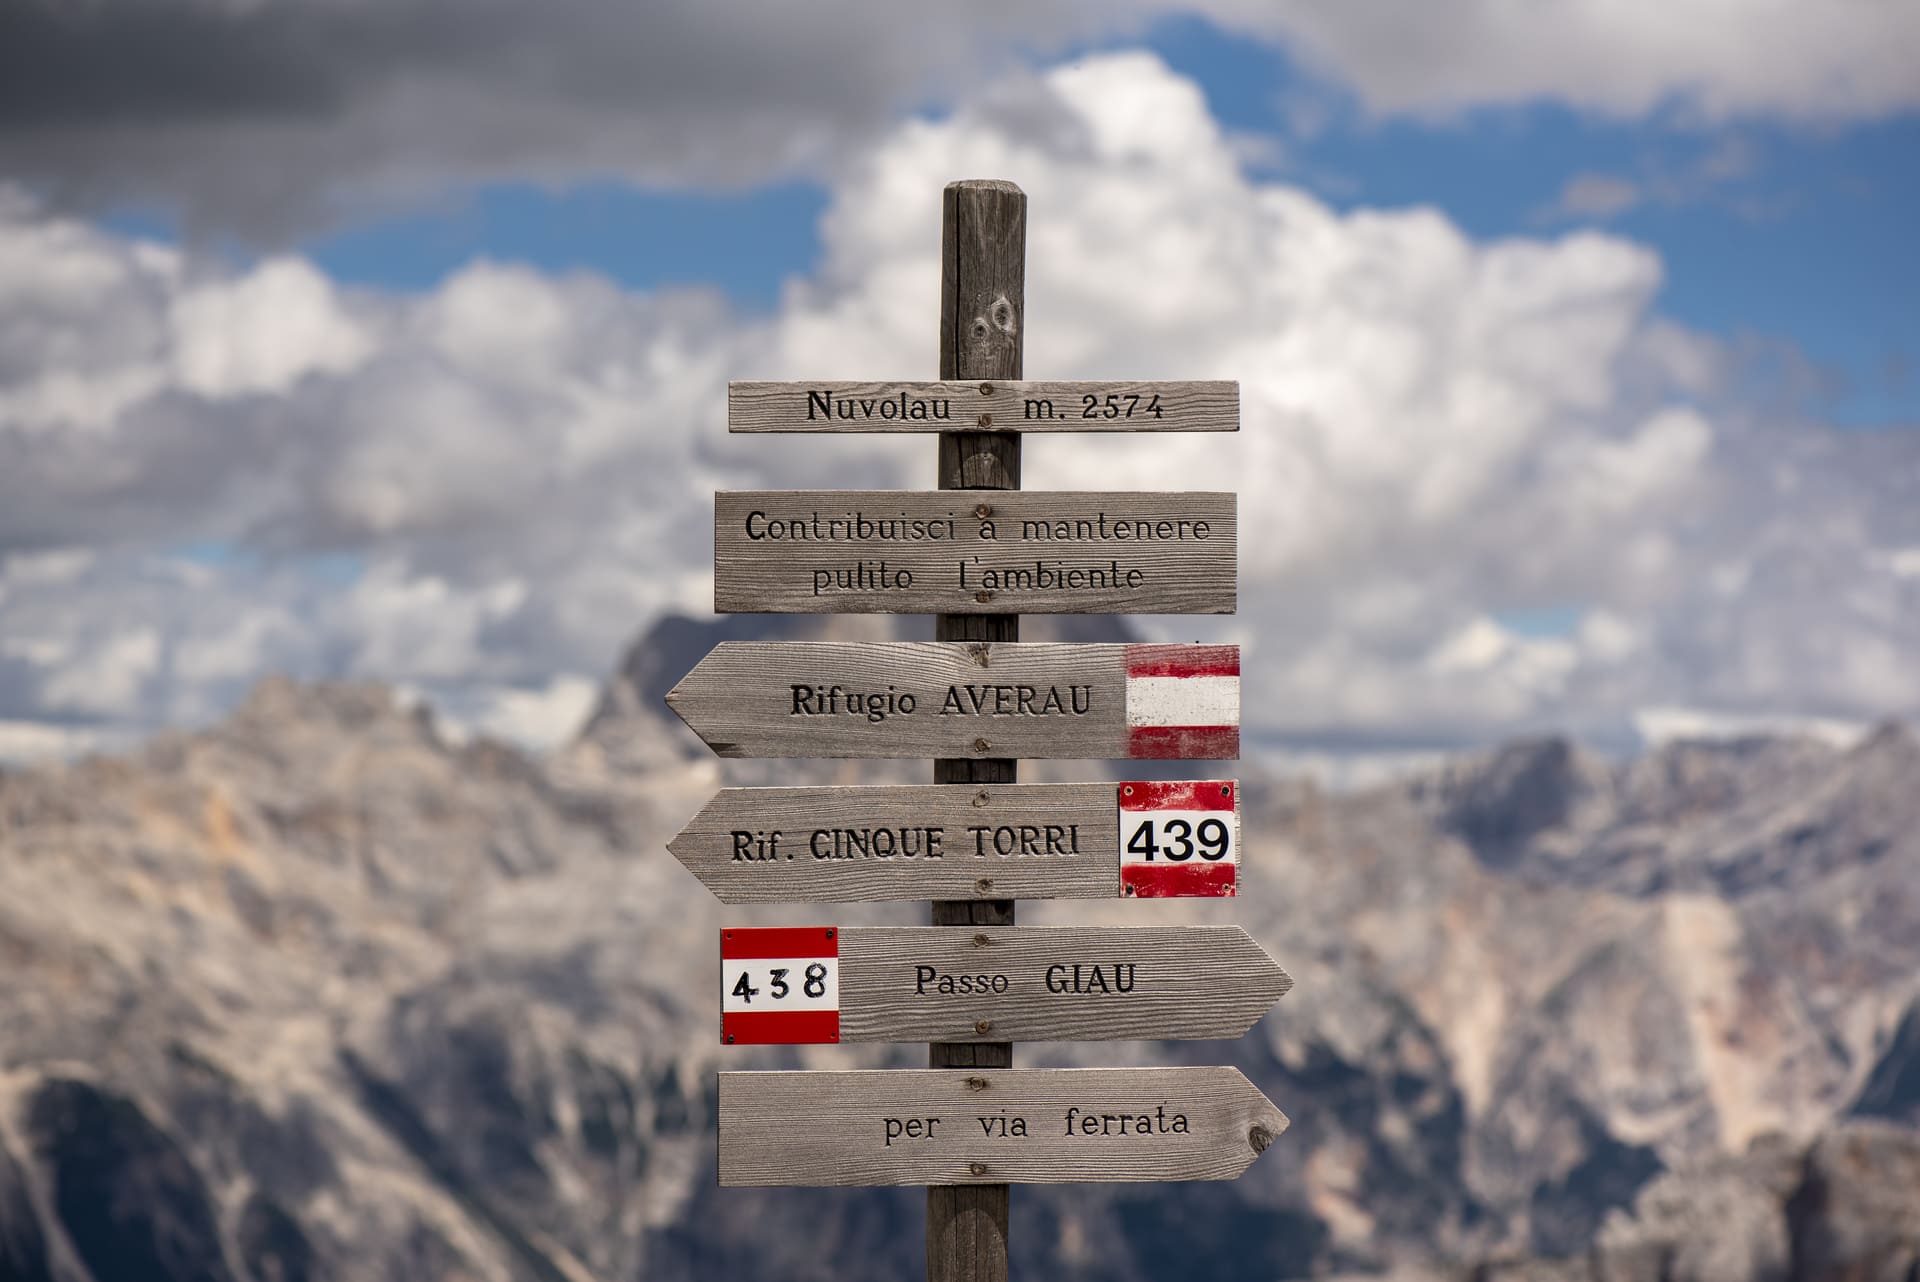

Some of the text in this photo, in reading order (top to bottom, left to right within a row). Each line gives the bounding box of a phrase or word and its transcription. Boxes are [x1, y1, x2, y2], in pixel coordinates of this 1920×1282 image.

[806, 390, 1164, 422] Nuvolau m. 2574
[745, 511, 1211, 541] Contribuisci a mantenere
[813, 557, 1145, 596] pulito l'ambiente
[790, 685, 1093, 723] Rifugio AVERAU
[730, 824, 1080, 862] Rif. CINQUE TORRI
[1127, 819, 1230, 862] 439
[914, 963, 1137, 995] Passo GIAU
[883, 1105, 1191, 1148] per via ferrata
